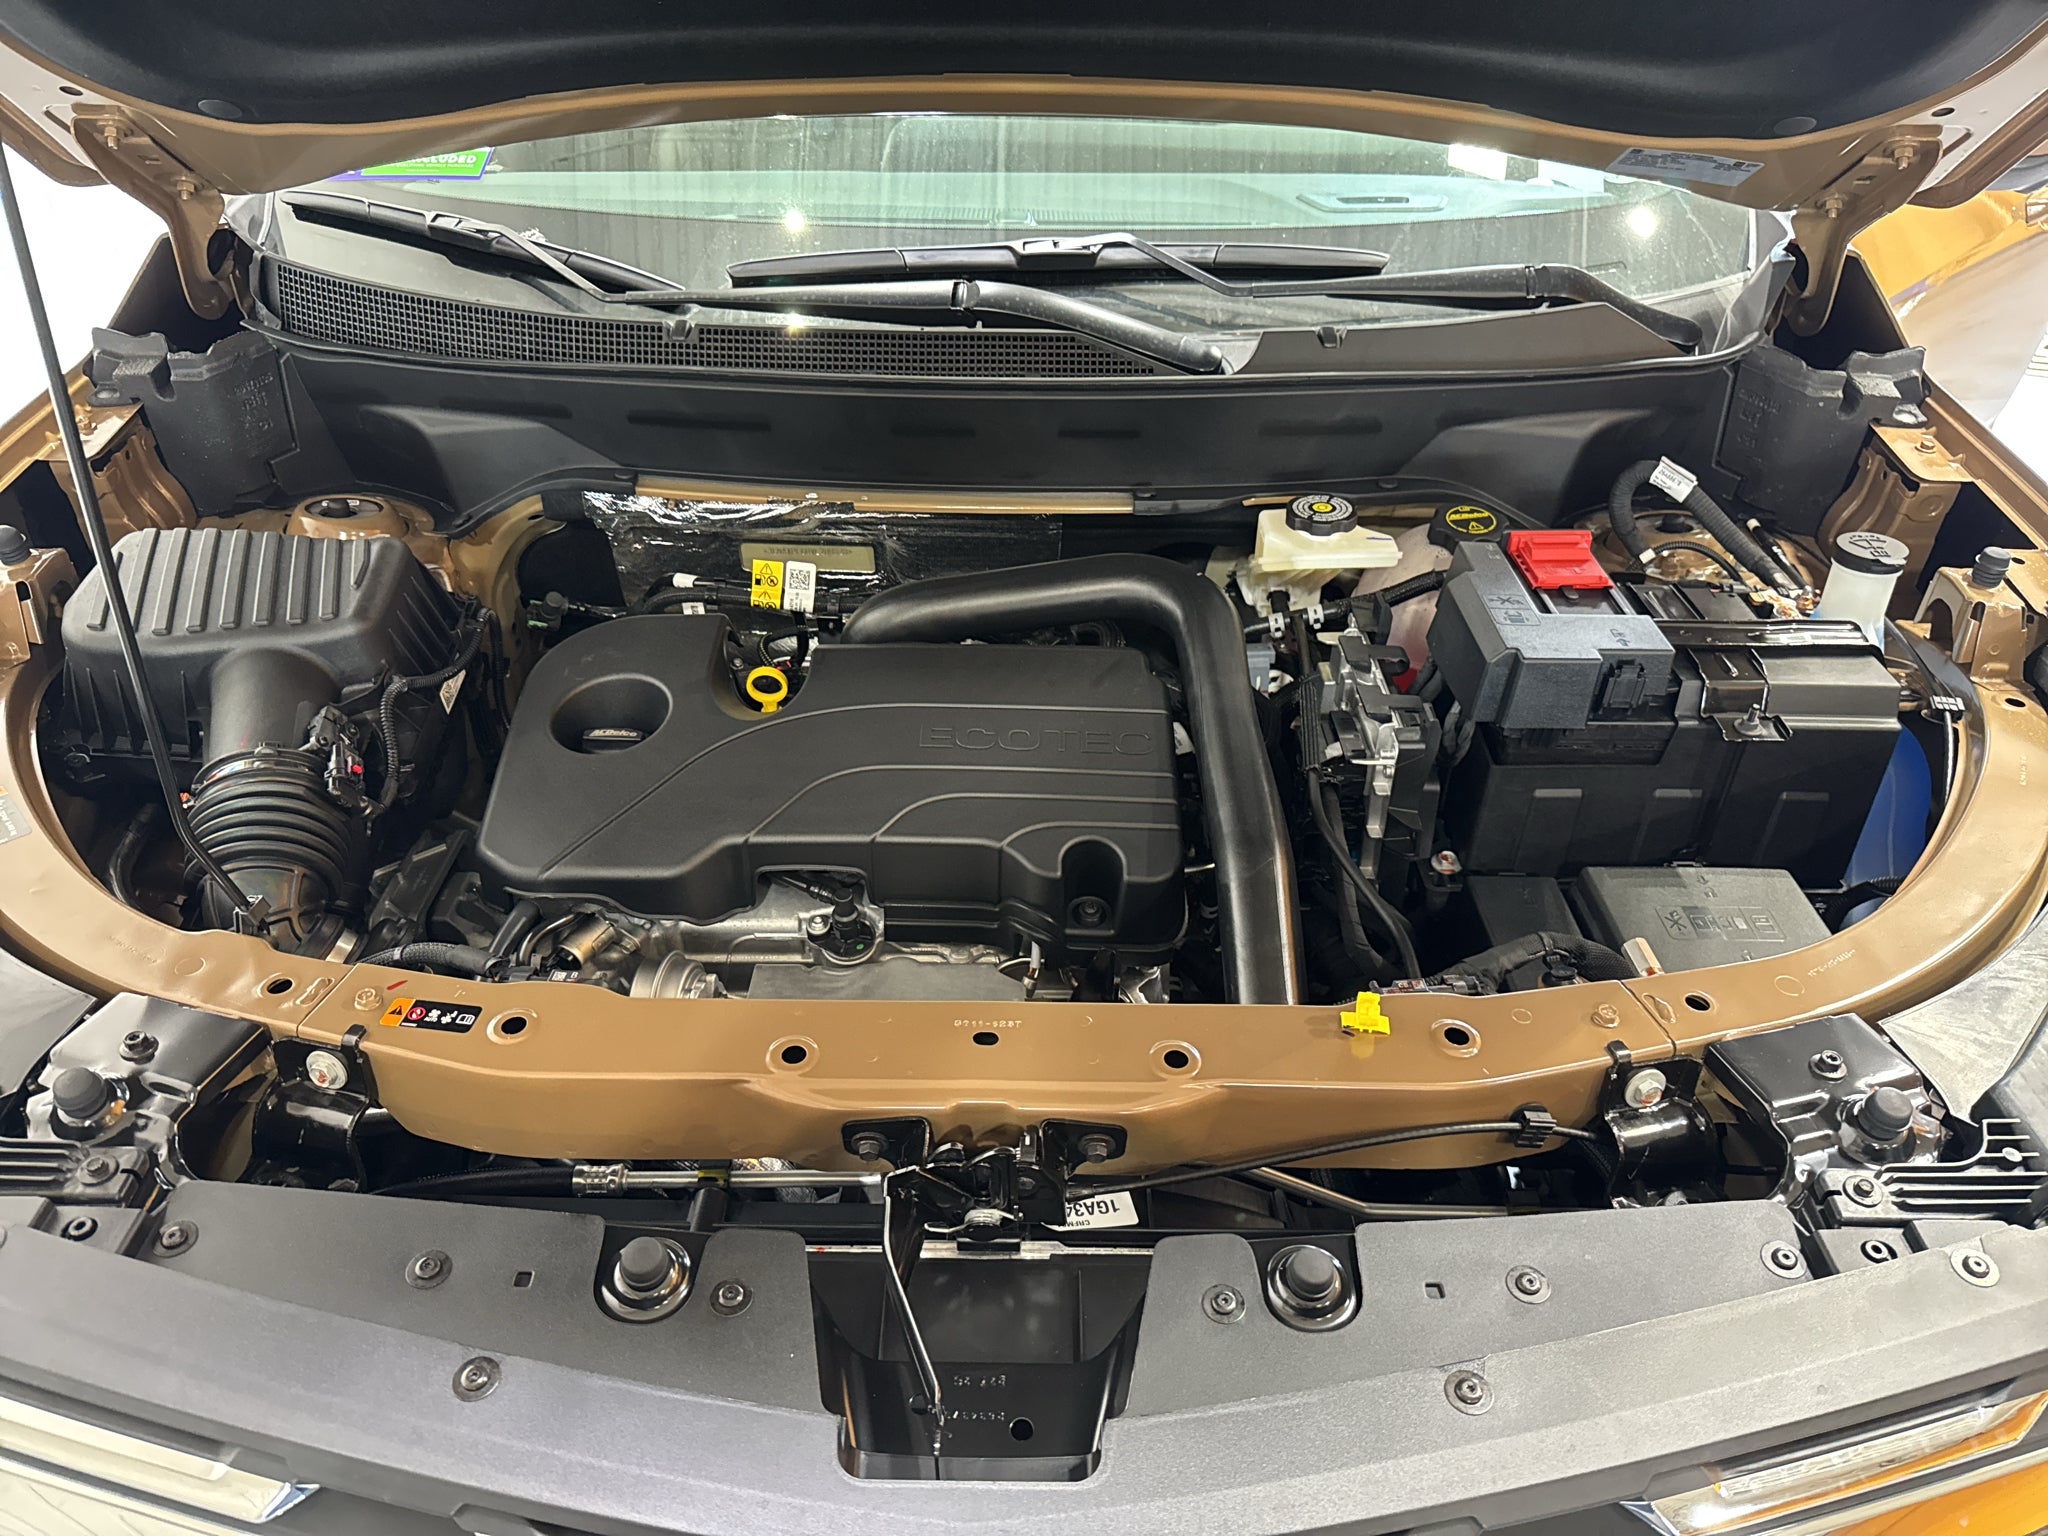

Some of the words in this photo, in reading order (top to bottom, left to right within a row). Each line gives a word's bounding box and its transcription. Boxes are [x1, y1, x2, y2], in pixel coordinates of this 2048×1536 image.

[411, 154, 477, 163] CLUDED
[589, 729, 637, 737] ACDelco
[920, 723, 1153, 755] ECOTEC
